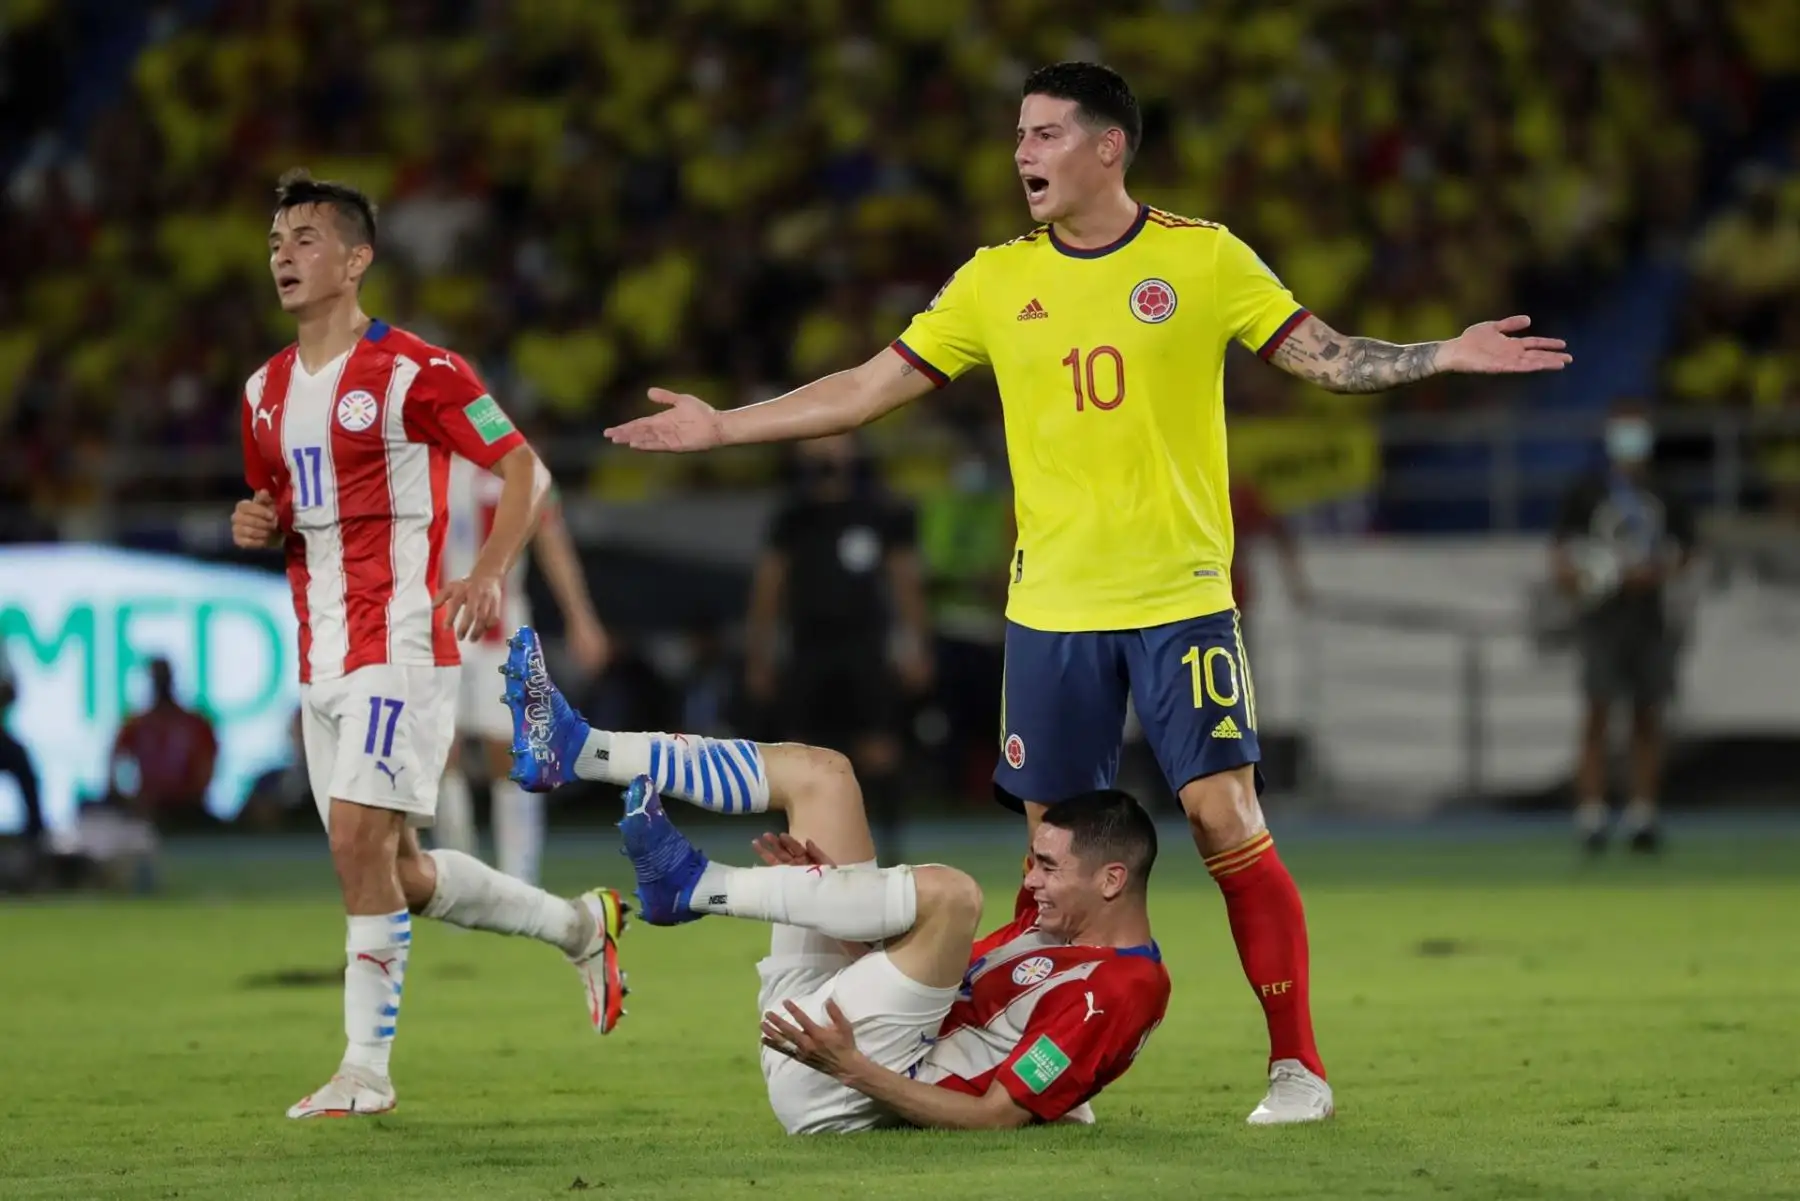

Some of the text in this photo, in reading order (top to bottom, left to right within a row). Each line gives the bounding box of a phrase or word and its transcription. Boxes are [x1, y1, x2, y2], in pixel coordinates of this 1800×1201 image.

[1016, 311, 1048, 321] adidas
[1062, 345, 1126, 412] 10
[292, 446, 324, 507] 17
[1181, 645, 1240, 709] 10
[364, 696, 405, 758] 17
[1211, 729, 1243, 740] adidas
[1261, 980, 1293, 998] FCF
